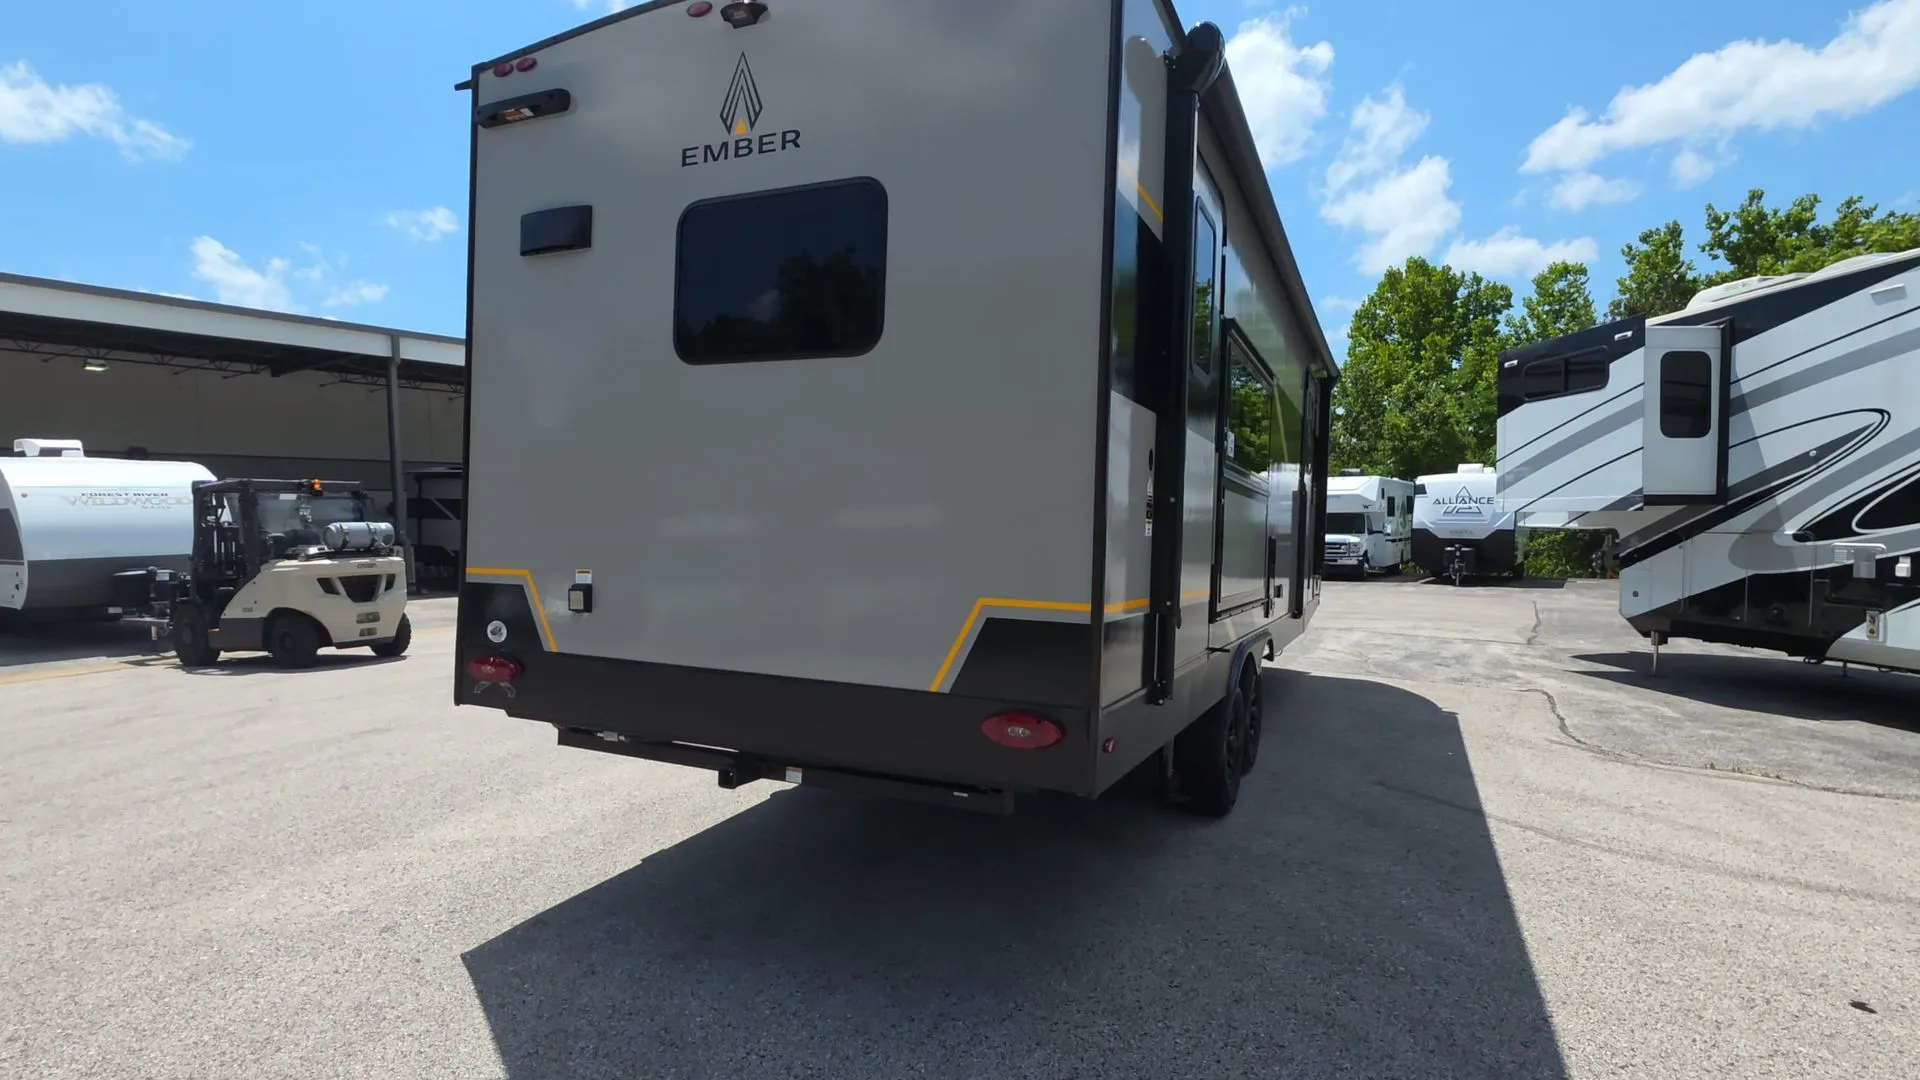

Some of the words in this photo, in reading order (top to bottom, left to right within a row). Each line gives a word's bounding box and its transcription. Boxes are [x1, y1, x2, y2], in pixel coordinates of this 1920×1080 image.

[681, 129, 801, 168] EMBER
[61, 495, 192, 506] WILDWOOD
[1432, 496, 1495, 505] ALLIANCE
